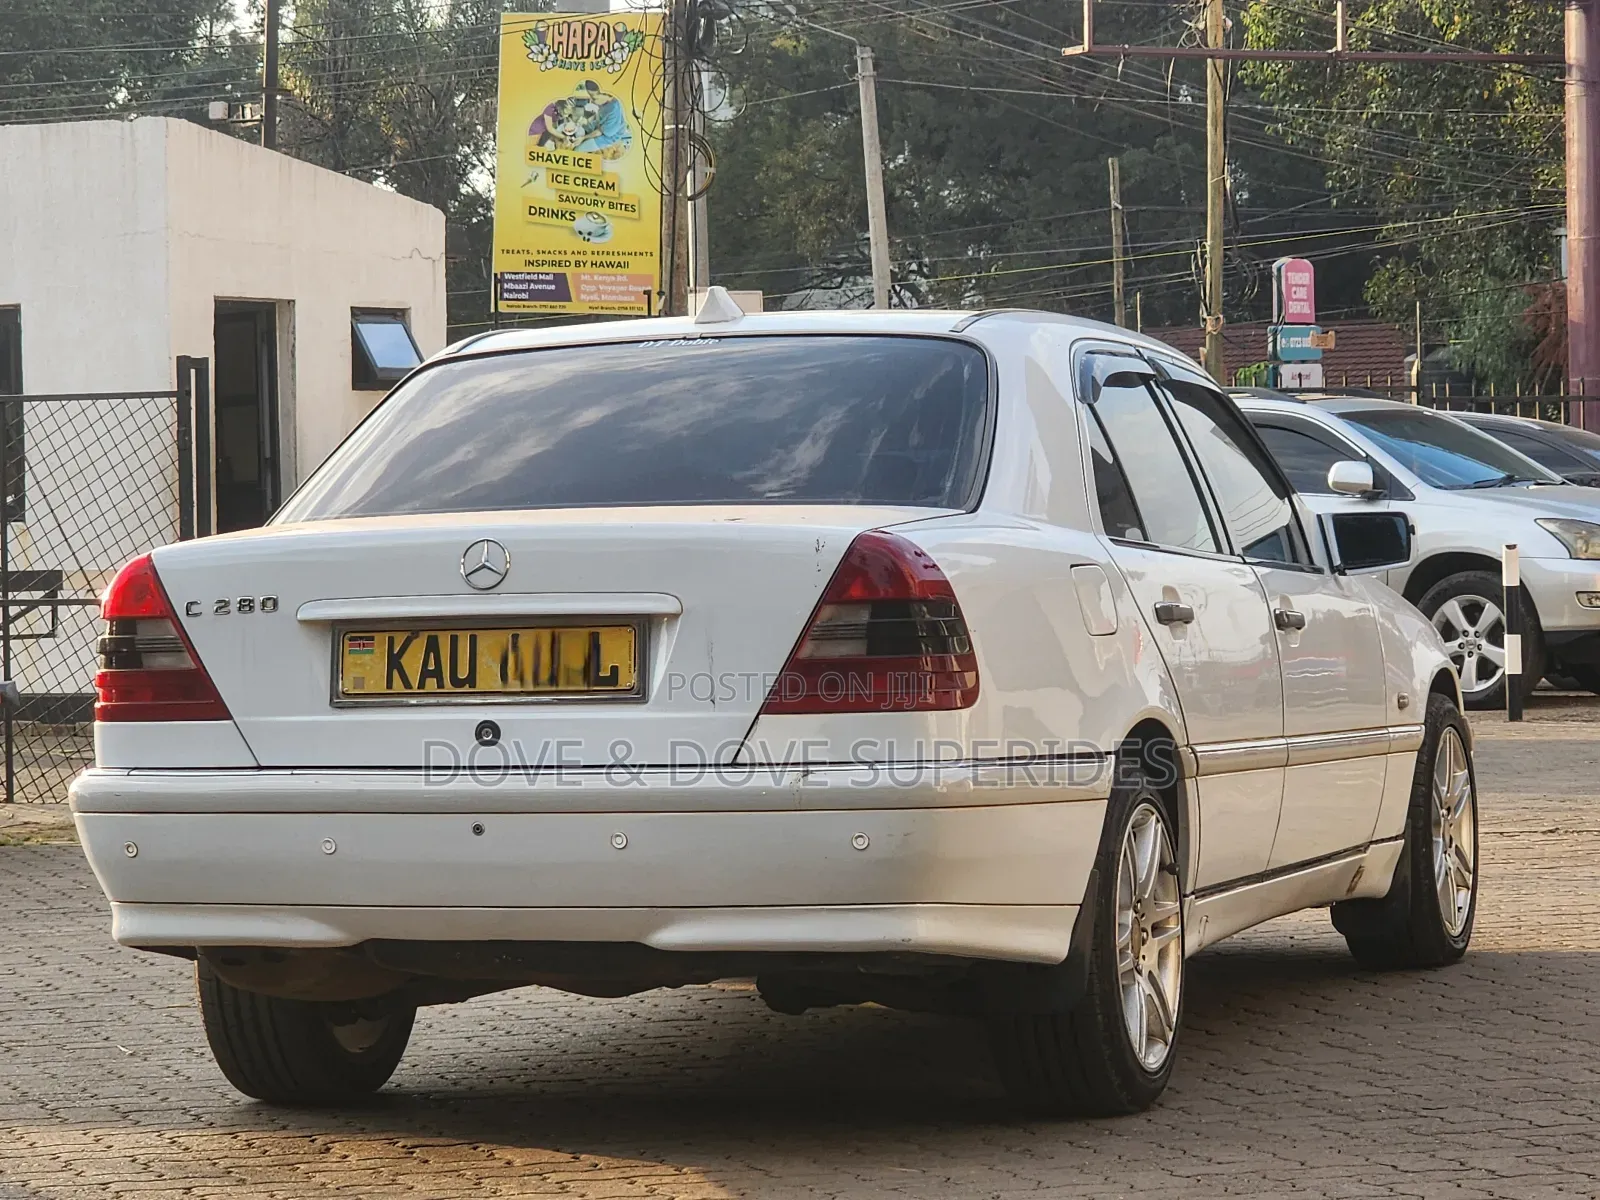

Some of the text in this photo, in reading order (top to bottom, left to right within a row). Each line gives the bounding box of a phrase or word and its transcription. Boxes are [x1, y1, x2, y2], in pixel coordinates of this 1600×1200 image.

[552, 21, 611, 60] HAPA
[553, 58, 586, 72] SHAVE
[528, 151, 593, 169] SHAVE ICE
[551, 173, 616, 192] ICE CREAM
[558, 194, 637, 213] SAVOURY BITES
[528, 206, 576, 222] DRINKS
[524, 259, 630, 269] INSPIRED BY HAWAII
[504, 273, 554, 281] Westfield Mall
[503, 291, 529, 299] Nairobi
[529, 283, 556, 291] Avenue
[1288, 301, 1311, 314] DENTAL
[184, 595, 279, 617] C 280
[385, 631, 477, 690] KAU
